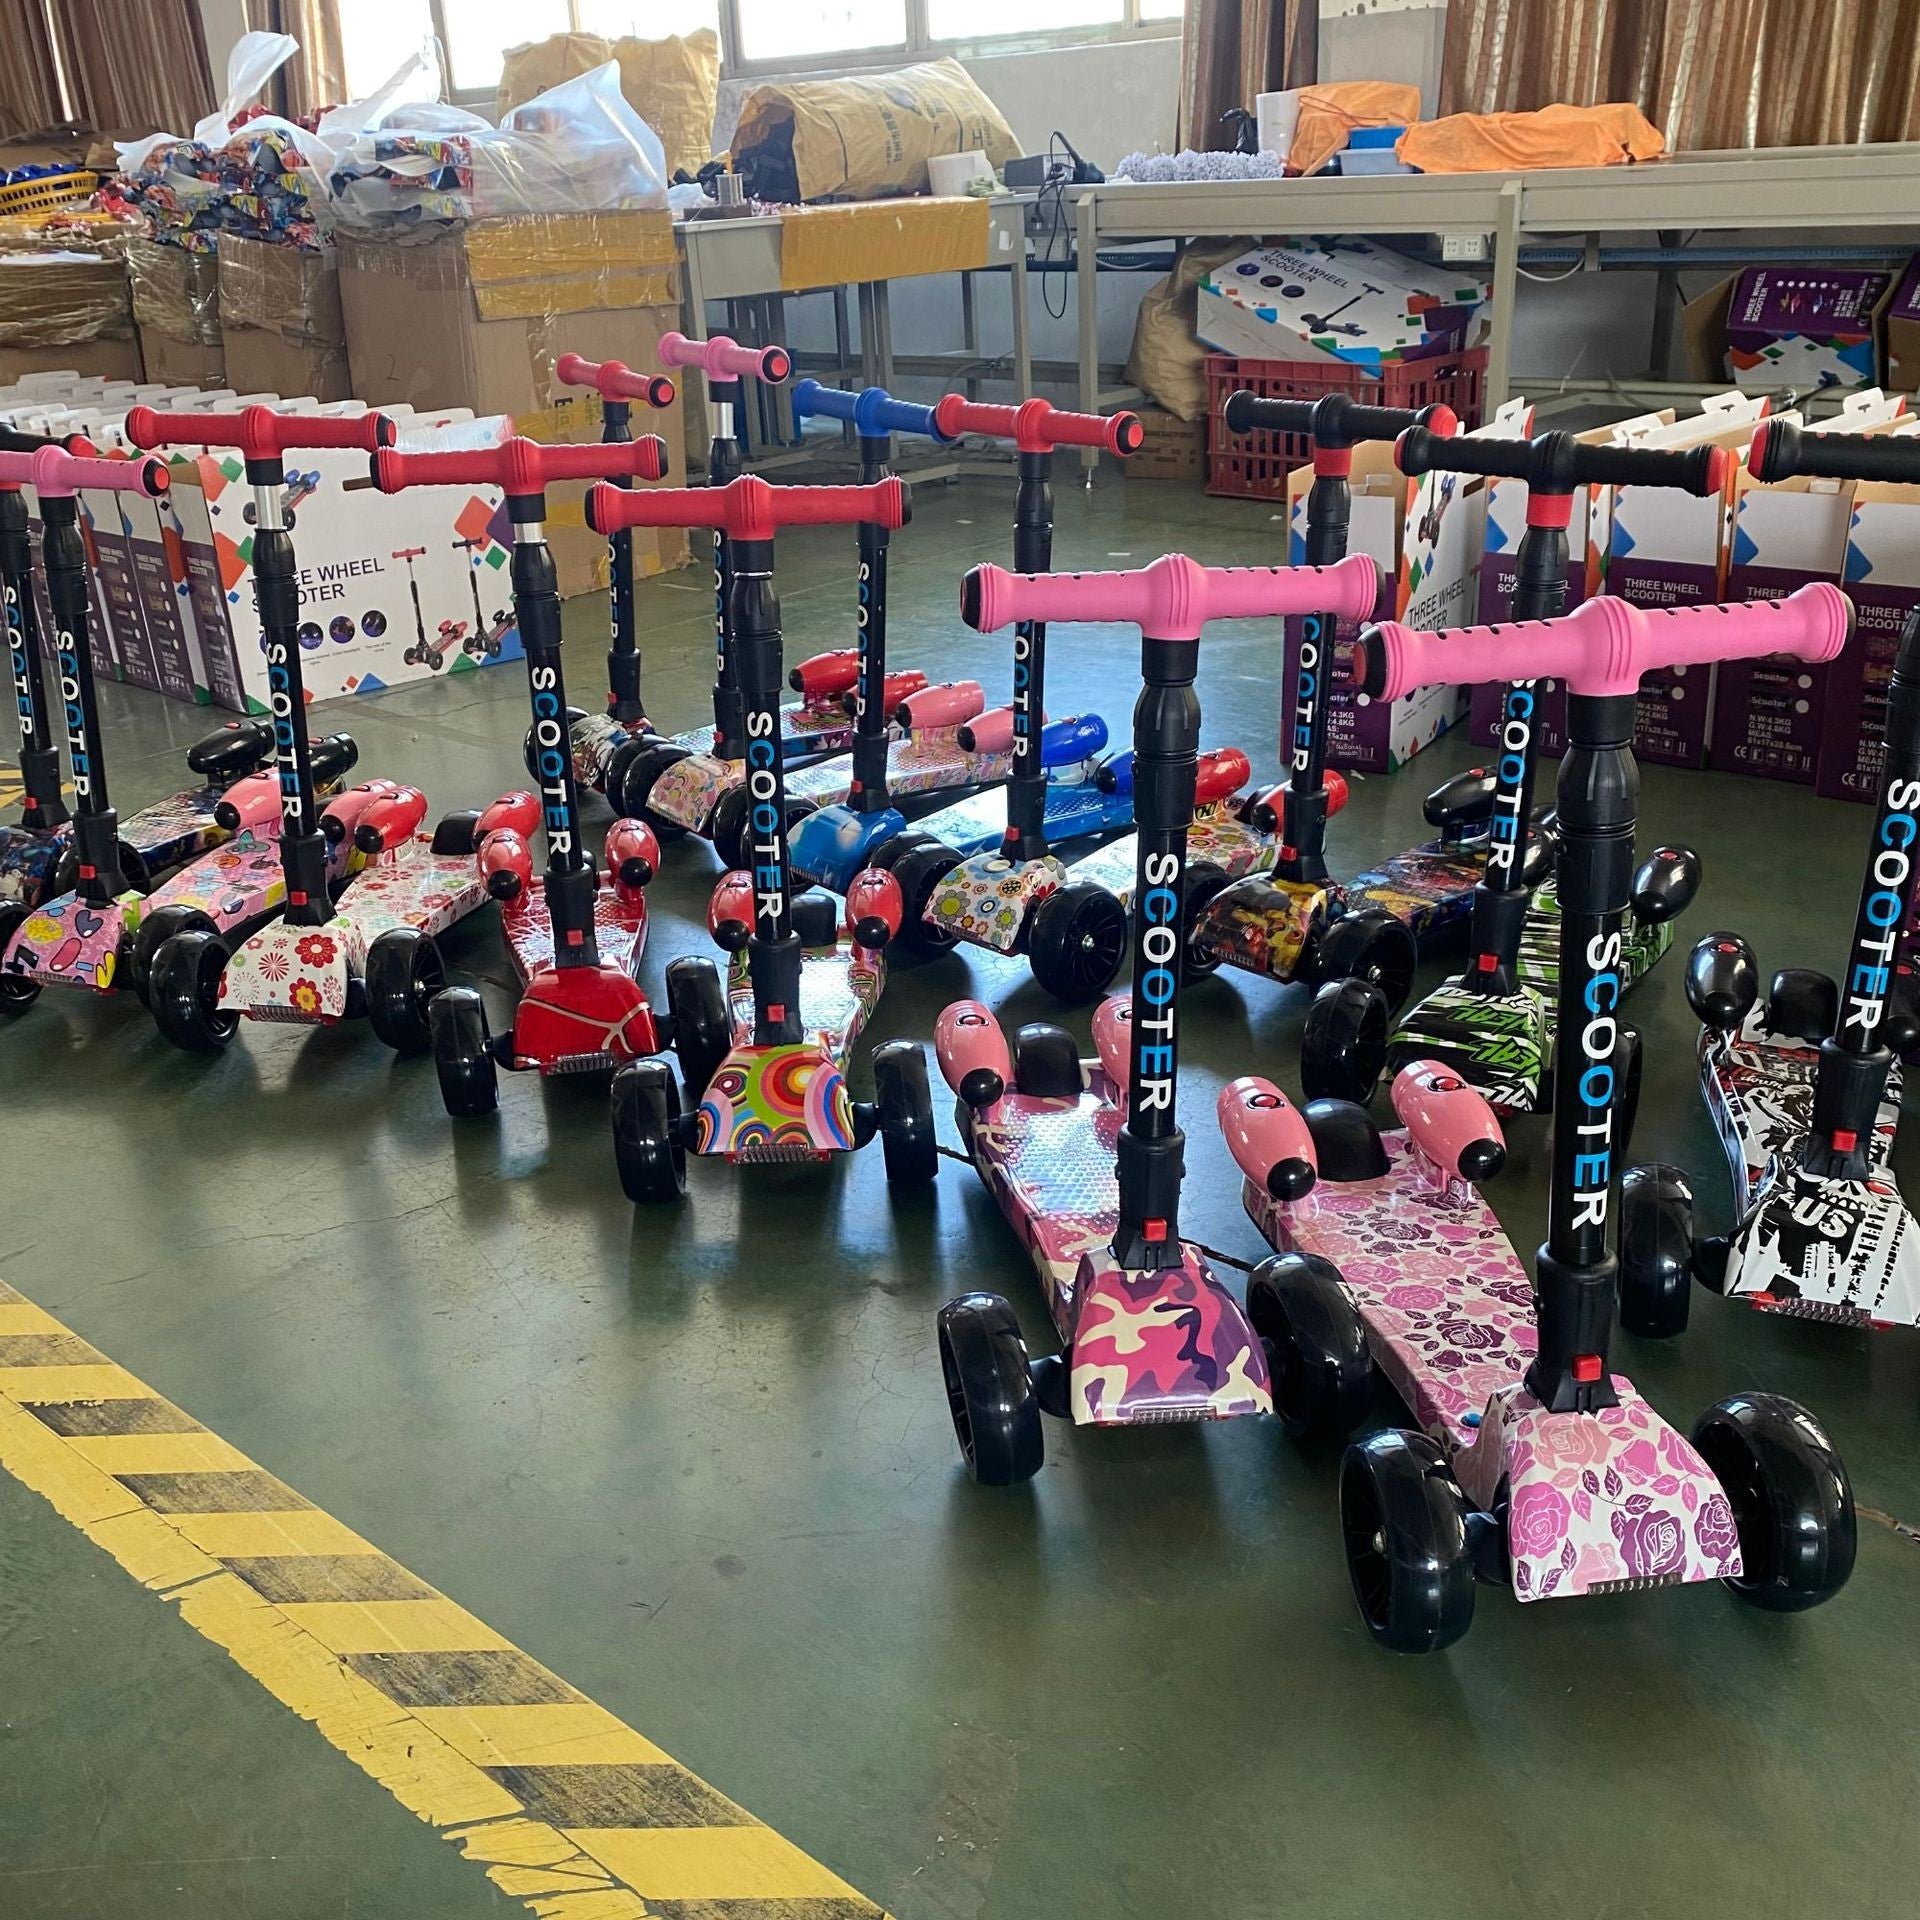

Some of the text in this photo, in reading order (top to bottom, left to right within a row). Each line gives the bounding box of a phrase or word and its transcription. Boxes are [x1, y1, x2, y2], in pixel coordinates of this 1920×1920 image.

[1260, 254, 1317, 283] SCOOTER
[1270, 249, 1306, 270] THREE
[1307, 265, 1349, 288] WHEEL
[317, 557, 385, 583] WHEEL
[1409, 578, 1466, 625] THREE WHEEL
[1624, 577, 1703, 595] THREE WHEEL
[1624, 588, 1677, 603] SCOOTER
[1746, 586, 1785, 598] THREE
[1857, 616, 1906, 631] SCOOT
[1859, 605, 1900, 619] THREE
[4, 586, 33, 735] SCOOTER
[55, 629, 89, 797] SCOOTER
[266, 643, 302, 818] SCOOTER
[1292, 611, 1320, 772] COOTER
[533, 666, 572, 855] SCOOTER
[747, 711, 784, 919] SCOOTER
[1489, 679, 1536, 869] COOTER
[1845, 779, 1920, 1028] SCOOTER
[1139, 852, 1179, 1112] SCOOTER
[1571, 931, 1622, 1231] SCOOTER
